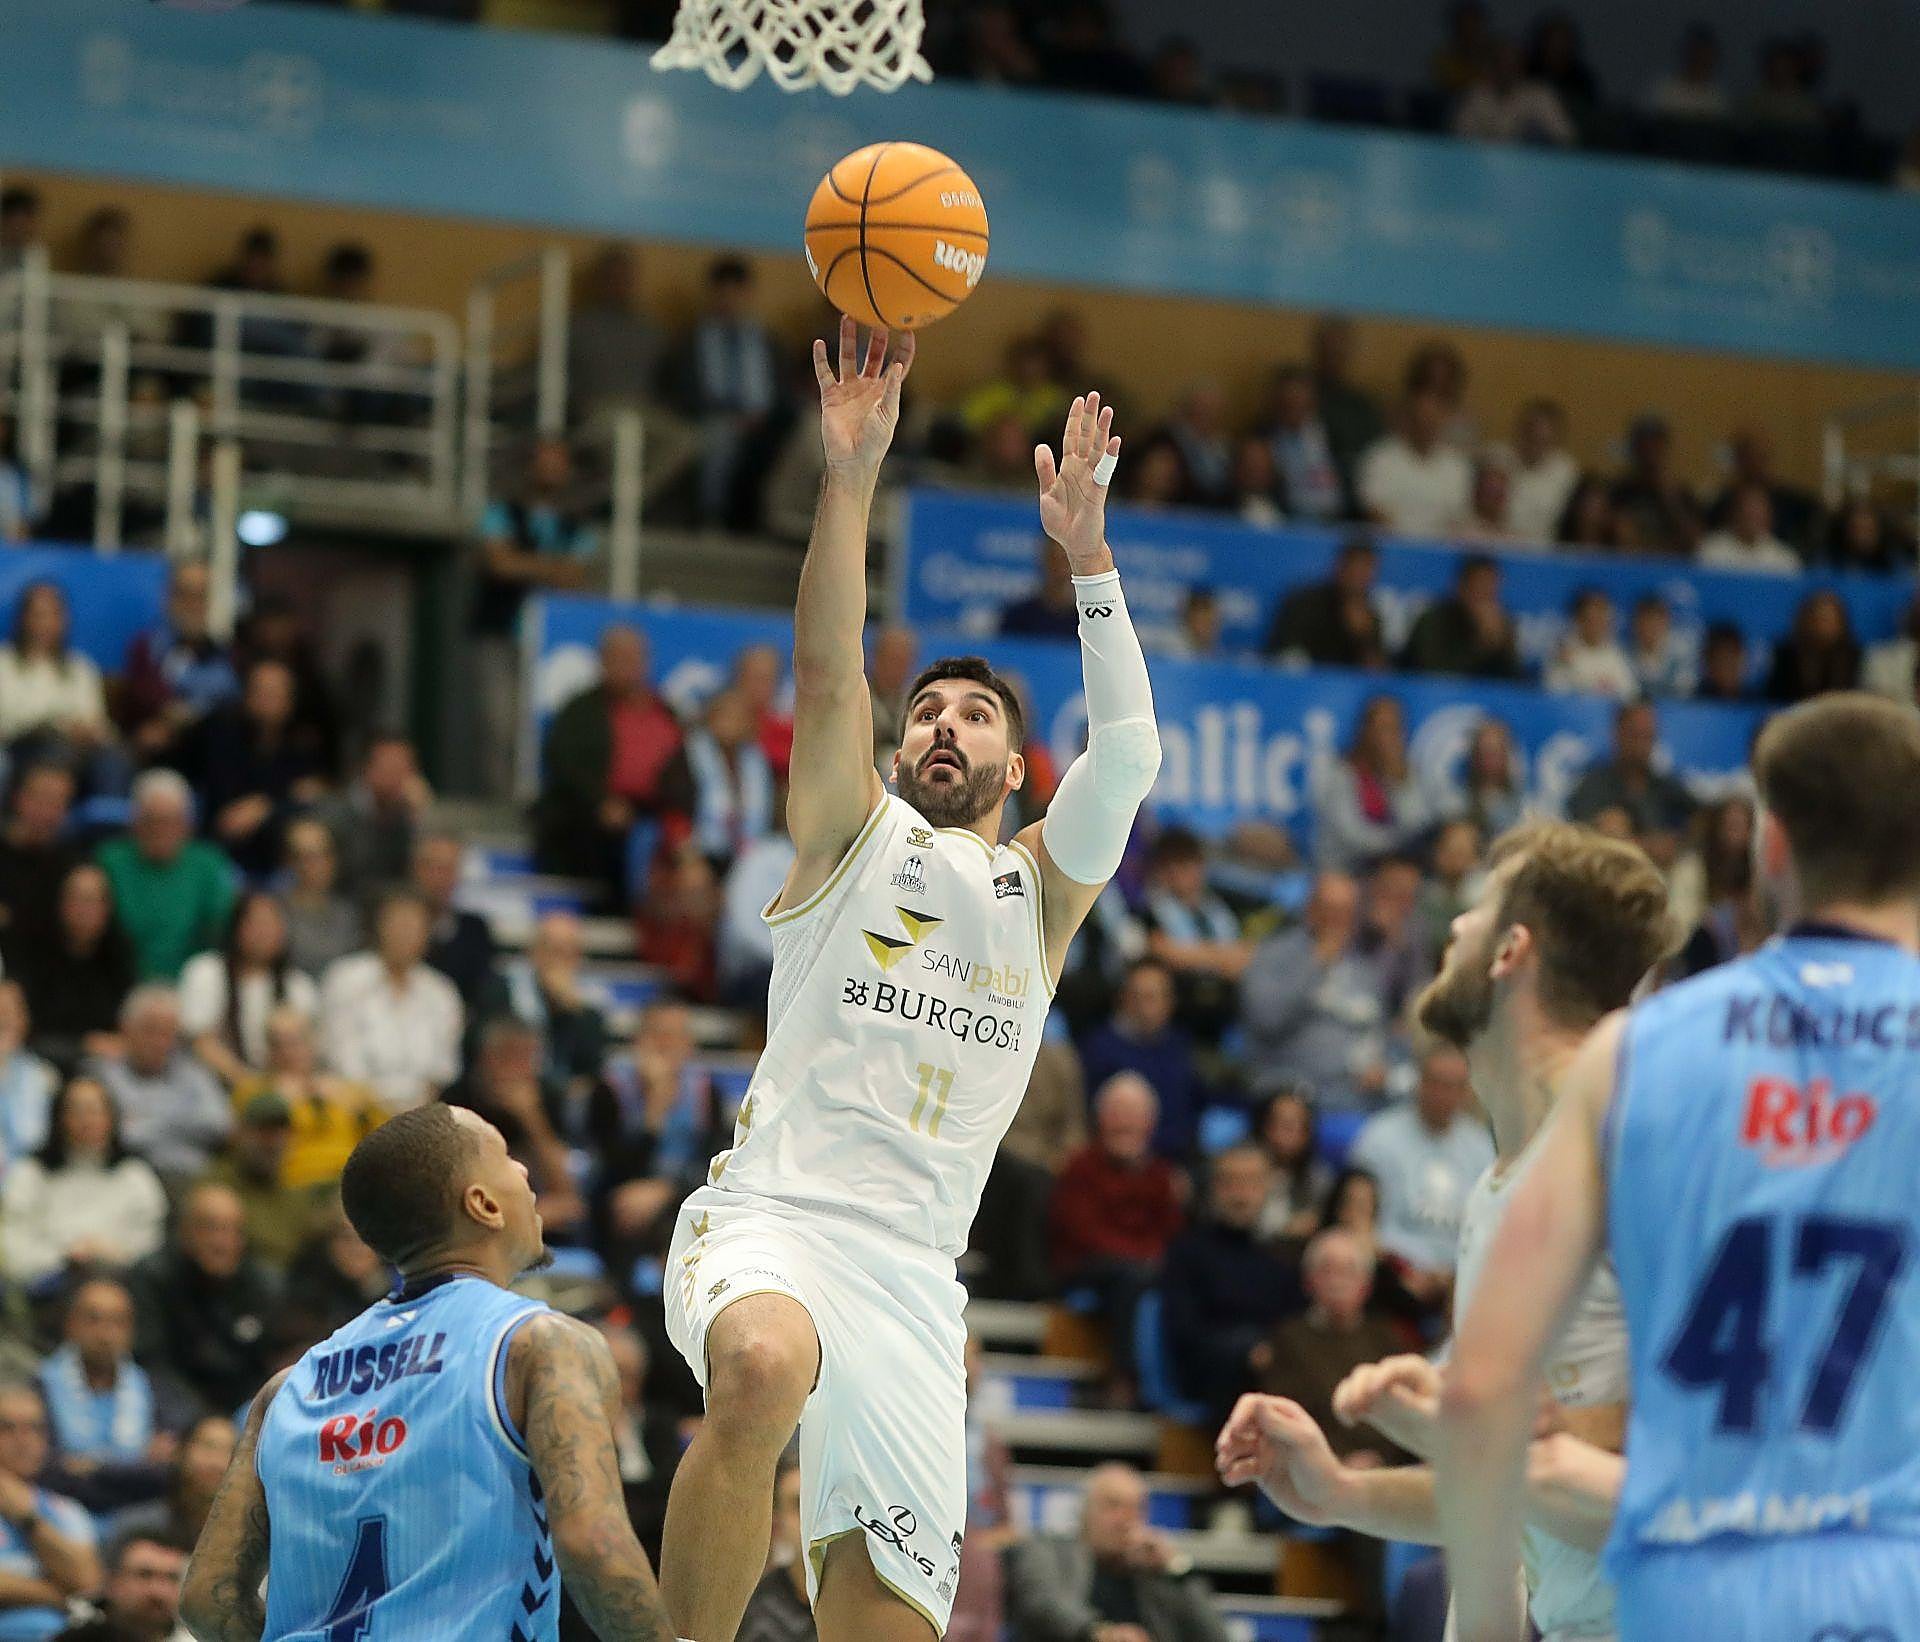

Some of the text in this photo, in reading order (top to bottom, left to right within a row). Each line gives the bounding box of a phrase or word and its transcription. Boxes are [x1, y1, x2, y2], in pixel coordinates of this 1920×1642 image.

[872, 981, 1014, 1049] BURGOS
[909, 1062, 955, 1138] 11
[1656, 1211, 1910, 1438] 47
[305, 1332, 447, 1401] RUSSELL
[318, 1406, 407, 1464] Río
[854, 1504, 936, 1577] LEXUS
[319, 1513, 391, 1642] 4
